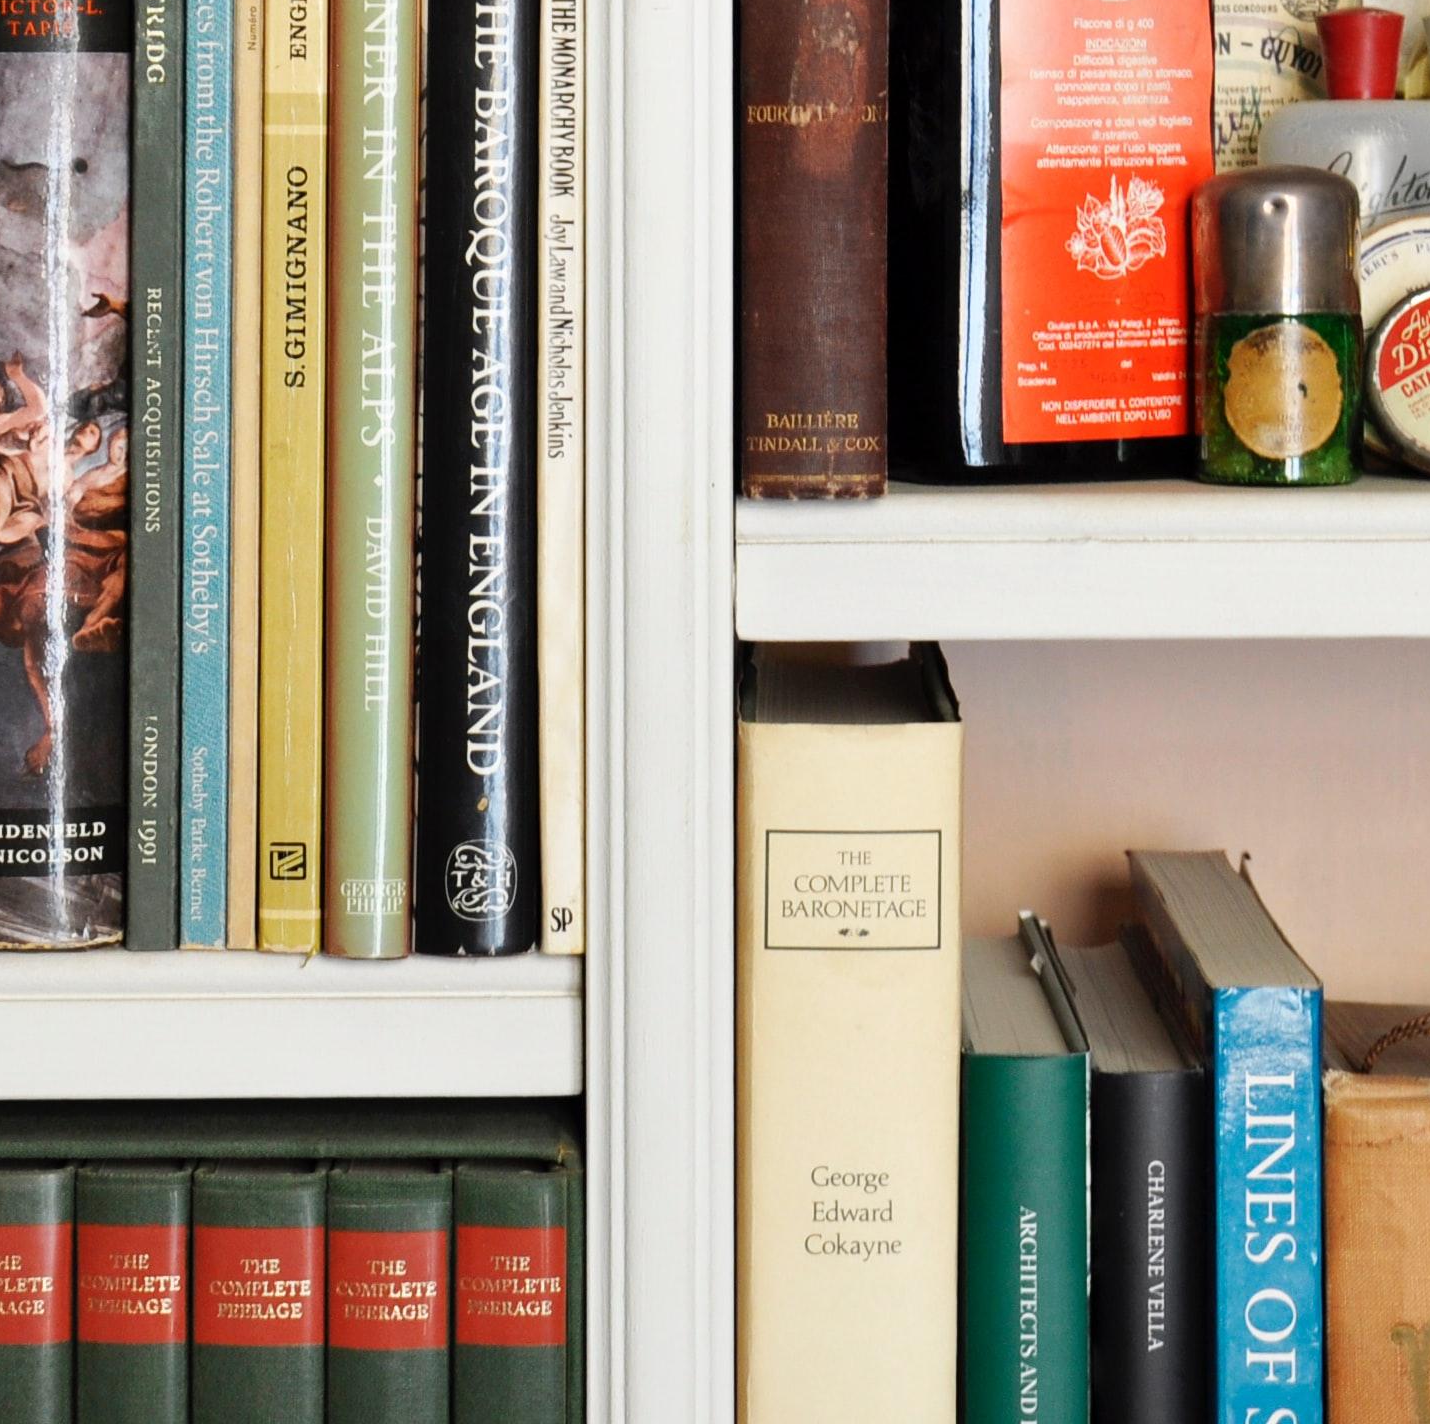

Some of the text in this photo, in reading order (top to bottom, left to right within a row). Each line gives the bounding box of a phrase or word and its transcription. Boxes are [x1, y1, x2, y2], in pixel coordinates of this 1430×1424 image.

[1073, 17, 1113, 29] Flacone
[195, 39, 223, 117] from
[548, 35, 576, 145] MONARCHY
[195, 119, 220, 161] the
[362, 125, 399, 183] IN
[548, 146, 576, 199] BOOK
[193, 166, 221, 264] Robert
[463, 86, 511, 334] BAROQUE
[284, 165, 309, 389] S. GIMIGNANO
[360, 208, 399, 308] THE
[192, 270, 216, 320] von
[192, 327, 222, 422] Hirsch
[360, 330, 398, 449] ALPS
[470, 350, 509, 448] AGE
[191, 430, 221, 485] Sale
[746, 433, 882, 454] TINDALL COX
[469, 463, 508, 517] IN
[186, 525, 219, 654] Sotheby's
[465, 532, 505, 777] ENGLAND
[187, 745, 209, 922] Sotheby Parke Bernet
[837, 850, 873, 867] THE
[340, 879, 406, 899] GEORGE
[345, 897, 403, 915] PHILIP
[780, 898, 928, 919] BARONETAGE
[793, 874, 912, 895] COMPLETE
[810, 1164, 890, 1193] George
[811, 1200, 894, 1224] Edward
[1242, 1071, 1298, 1385] LINES OF
[803, 1232, 903, 1261] Cokayne
[1146, 1159, 1167, 1352] CHARLENE VELLA
[1018, 1205, 1039, 1414] ARCHITECTS AND
